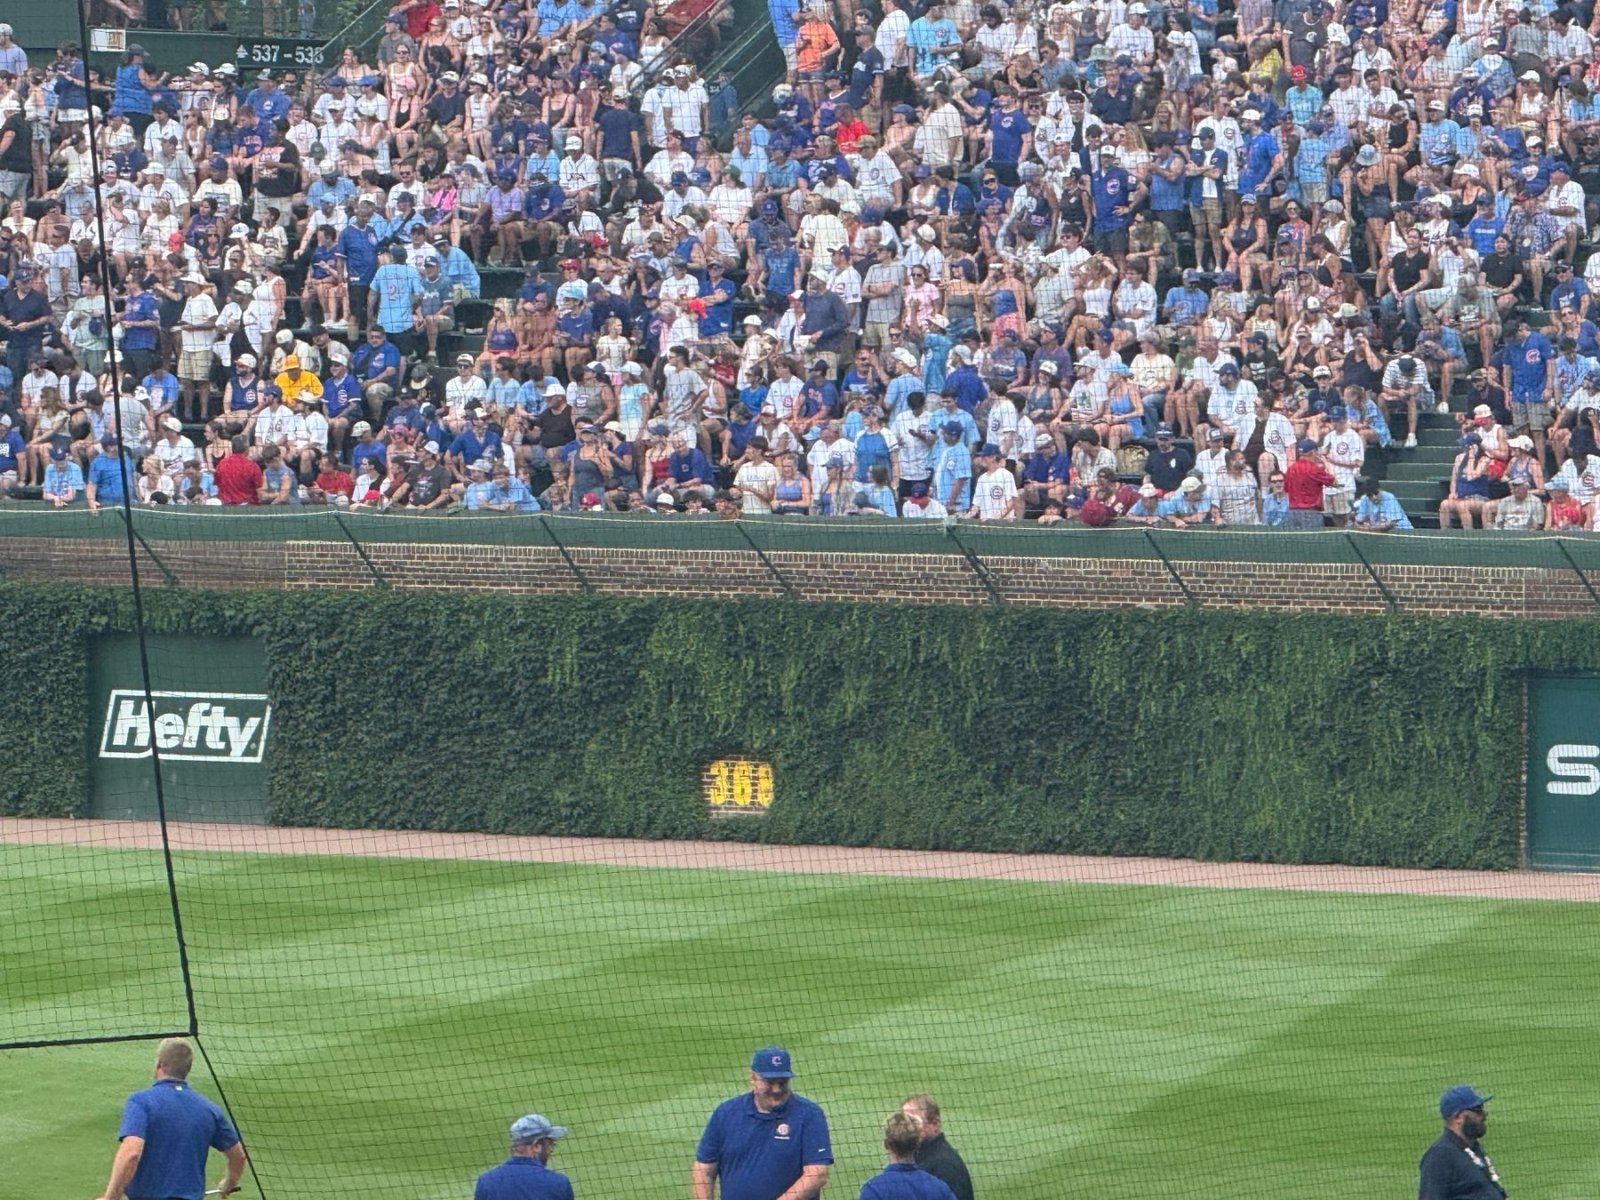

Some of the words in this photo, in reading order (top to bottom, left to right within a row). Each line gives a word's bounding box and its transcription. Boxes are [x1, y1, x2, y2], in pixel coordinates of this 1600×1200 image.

[252, 44, 280, 62] 537
[295, 46, 324, 64] 538
[112, 700, 261, 757] Hefty
[710, 760, 774, 808] 368
[1547, 744, 1600, 795] S
